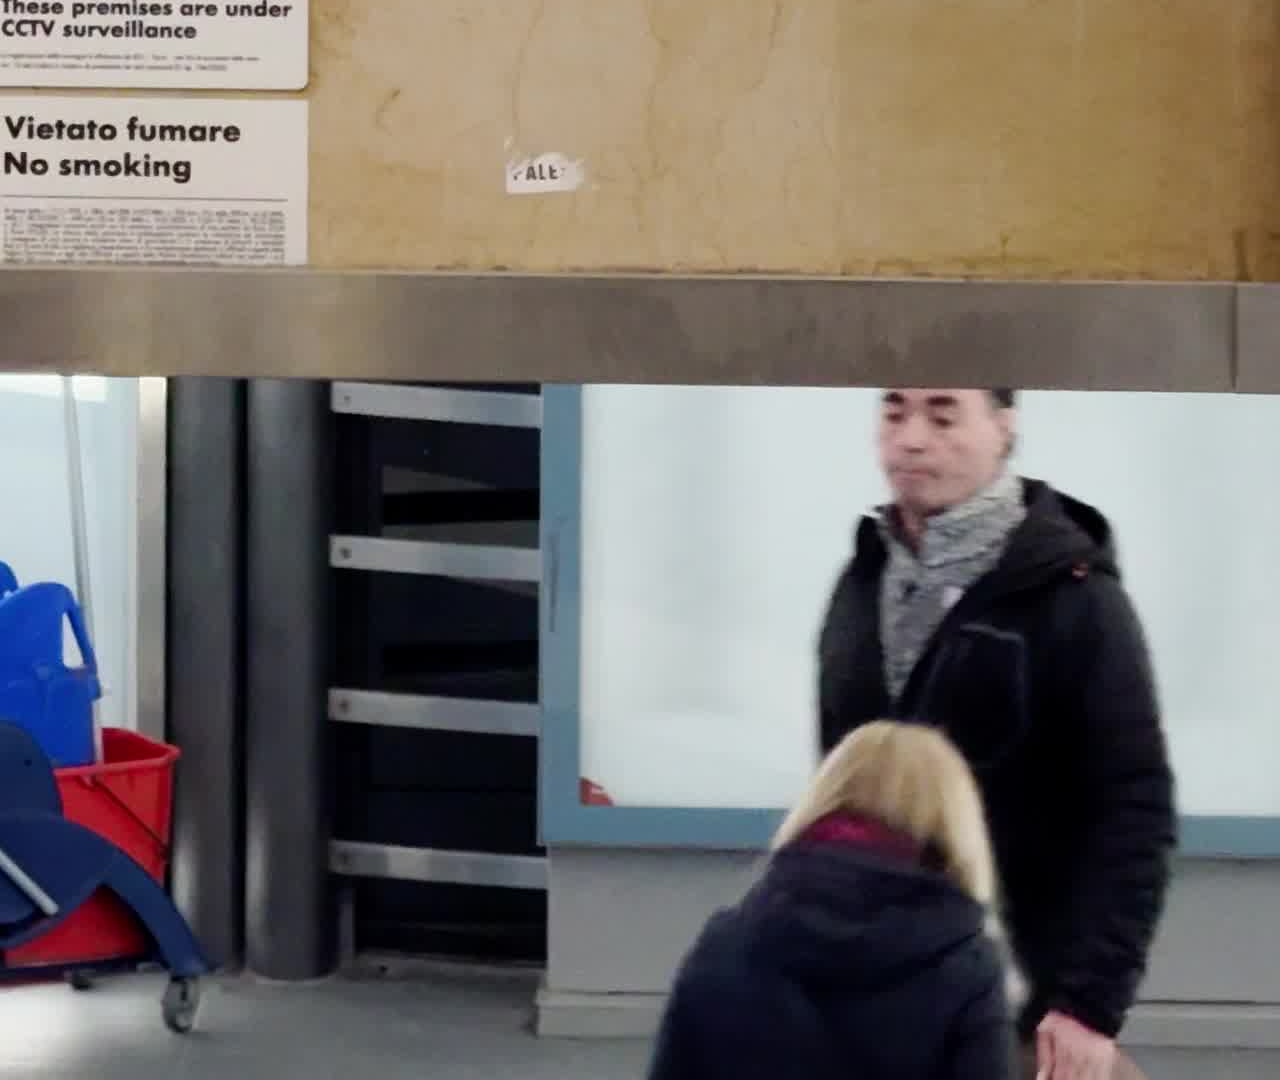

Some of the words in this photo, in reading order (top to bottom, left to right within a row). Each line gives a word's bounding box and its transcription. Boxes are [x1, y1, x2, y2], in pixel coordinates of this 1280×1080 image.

[179, 3, 218, 17] are
[225, 0, 293, 18] under
[1, 19, 55, 38] CCTV
[62, 20, 197, 39] surveillance
[4, 115, 118, 142] Vietato
[126, 115, 241, 143] fumare
[4, 151, 49, 176] No
[59, 152, 192, 184] smoking
